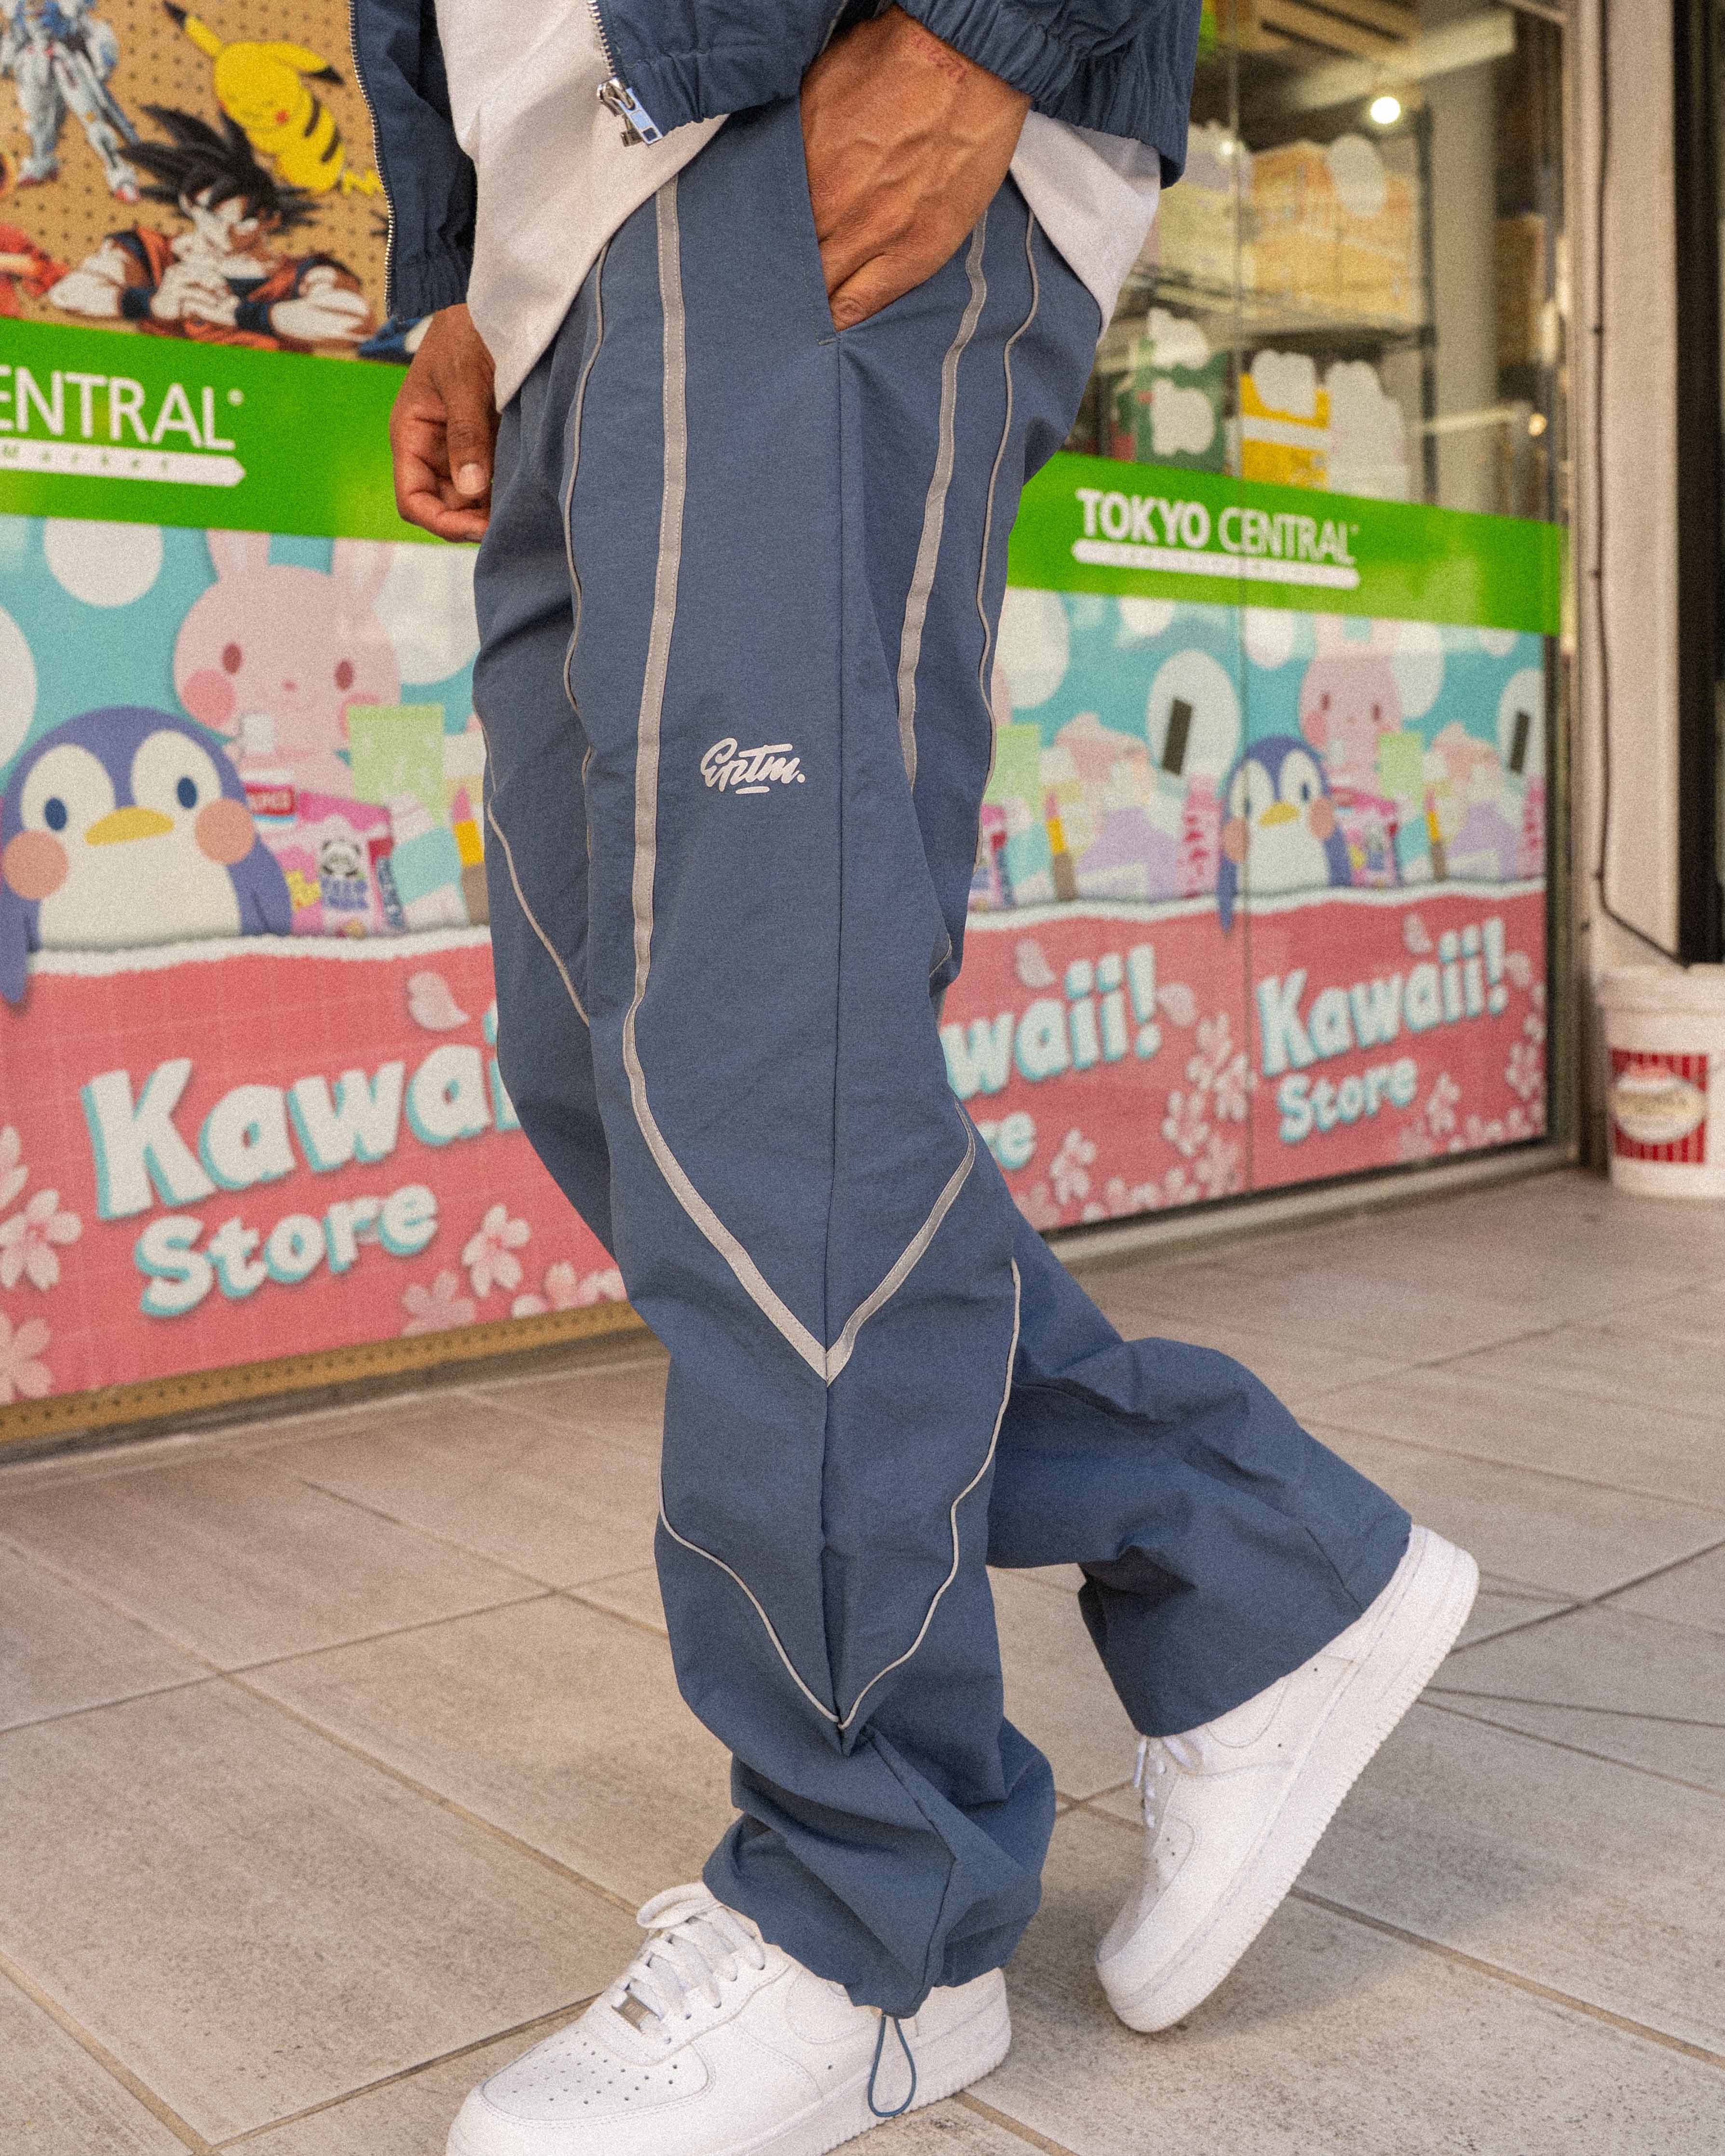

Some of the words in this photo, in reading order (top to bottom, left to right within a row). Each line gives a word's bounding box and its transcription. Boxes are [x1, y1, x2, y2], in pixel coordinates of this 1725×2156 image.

[1076, 488, 1210, 549] TOKYO
[1218, 506, 1354, 565] CENTRAL
[1256, 916, 1509, 1077] Kawaii!
[1277, 1057, 1418, 1144] Store
[134, 1184, 439, 1317] Store
